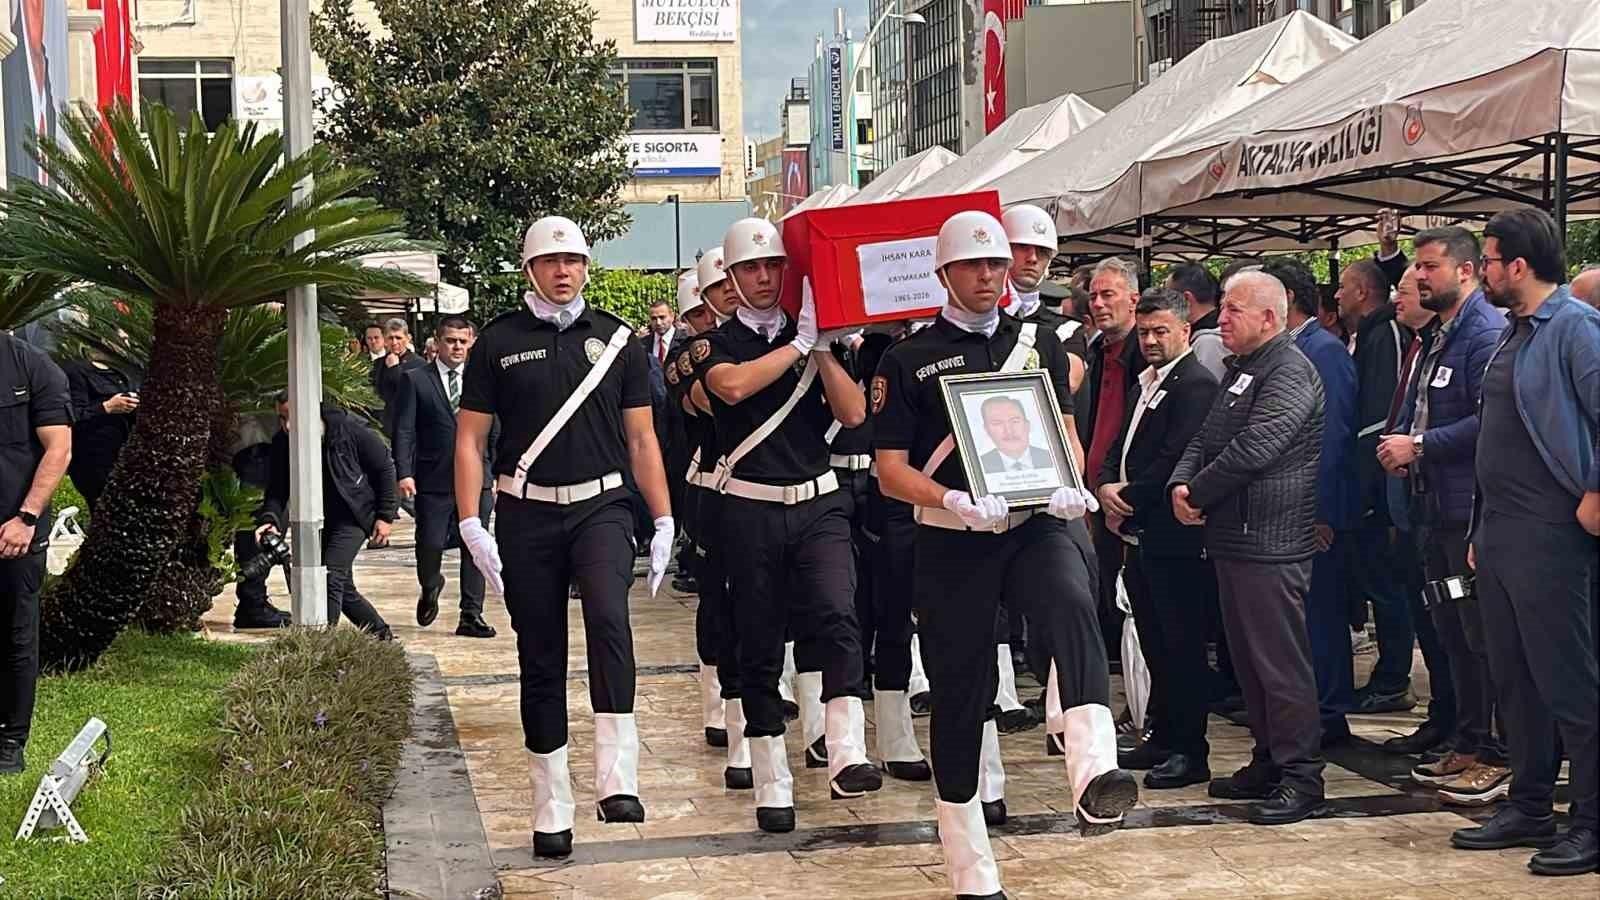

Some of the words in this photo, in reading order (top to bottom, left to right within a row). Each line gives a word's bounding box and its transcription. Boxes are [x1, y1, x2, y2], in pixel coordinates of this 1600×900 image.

[655, 8, 720, 28] BEKÇİSİ
[909, 249, 932, 259] KARA
[520, 349, 546, 361] KUVVET
[936, 355, 965, 371] KUVVET
